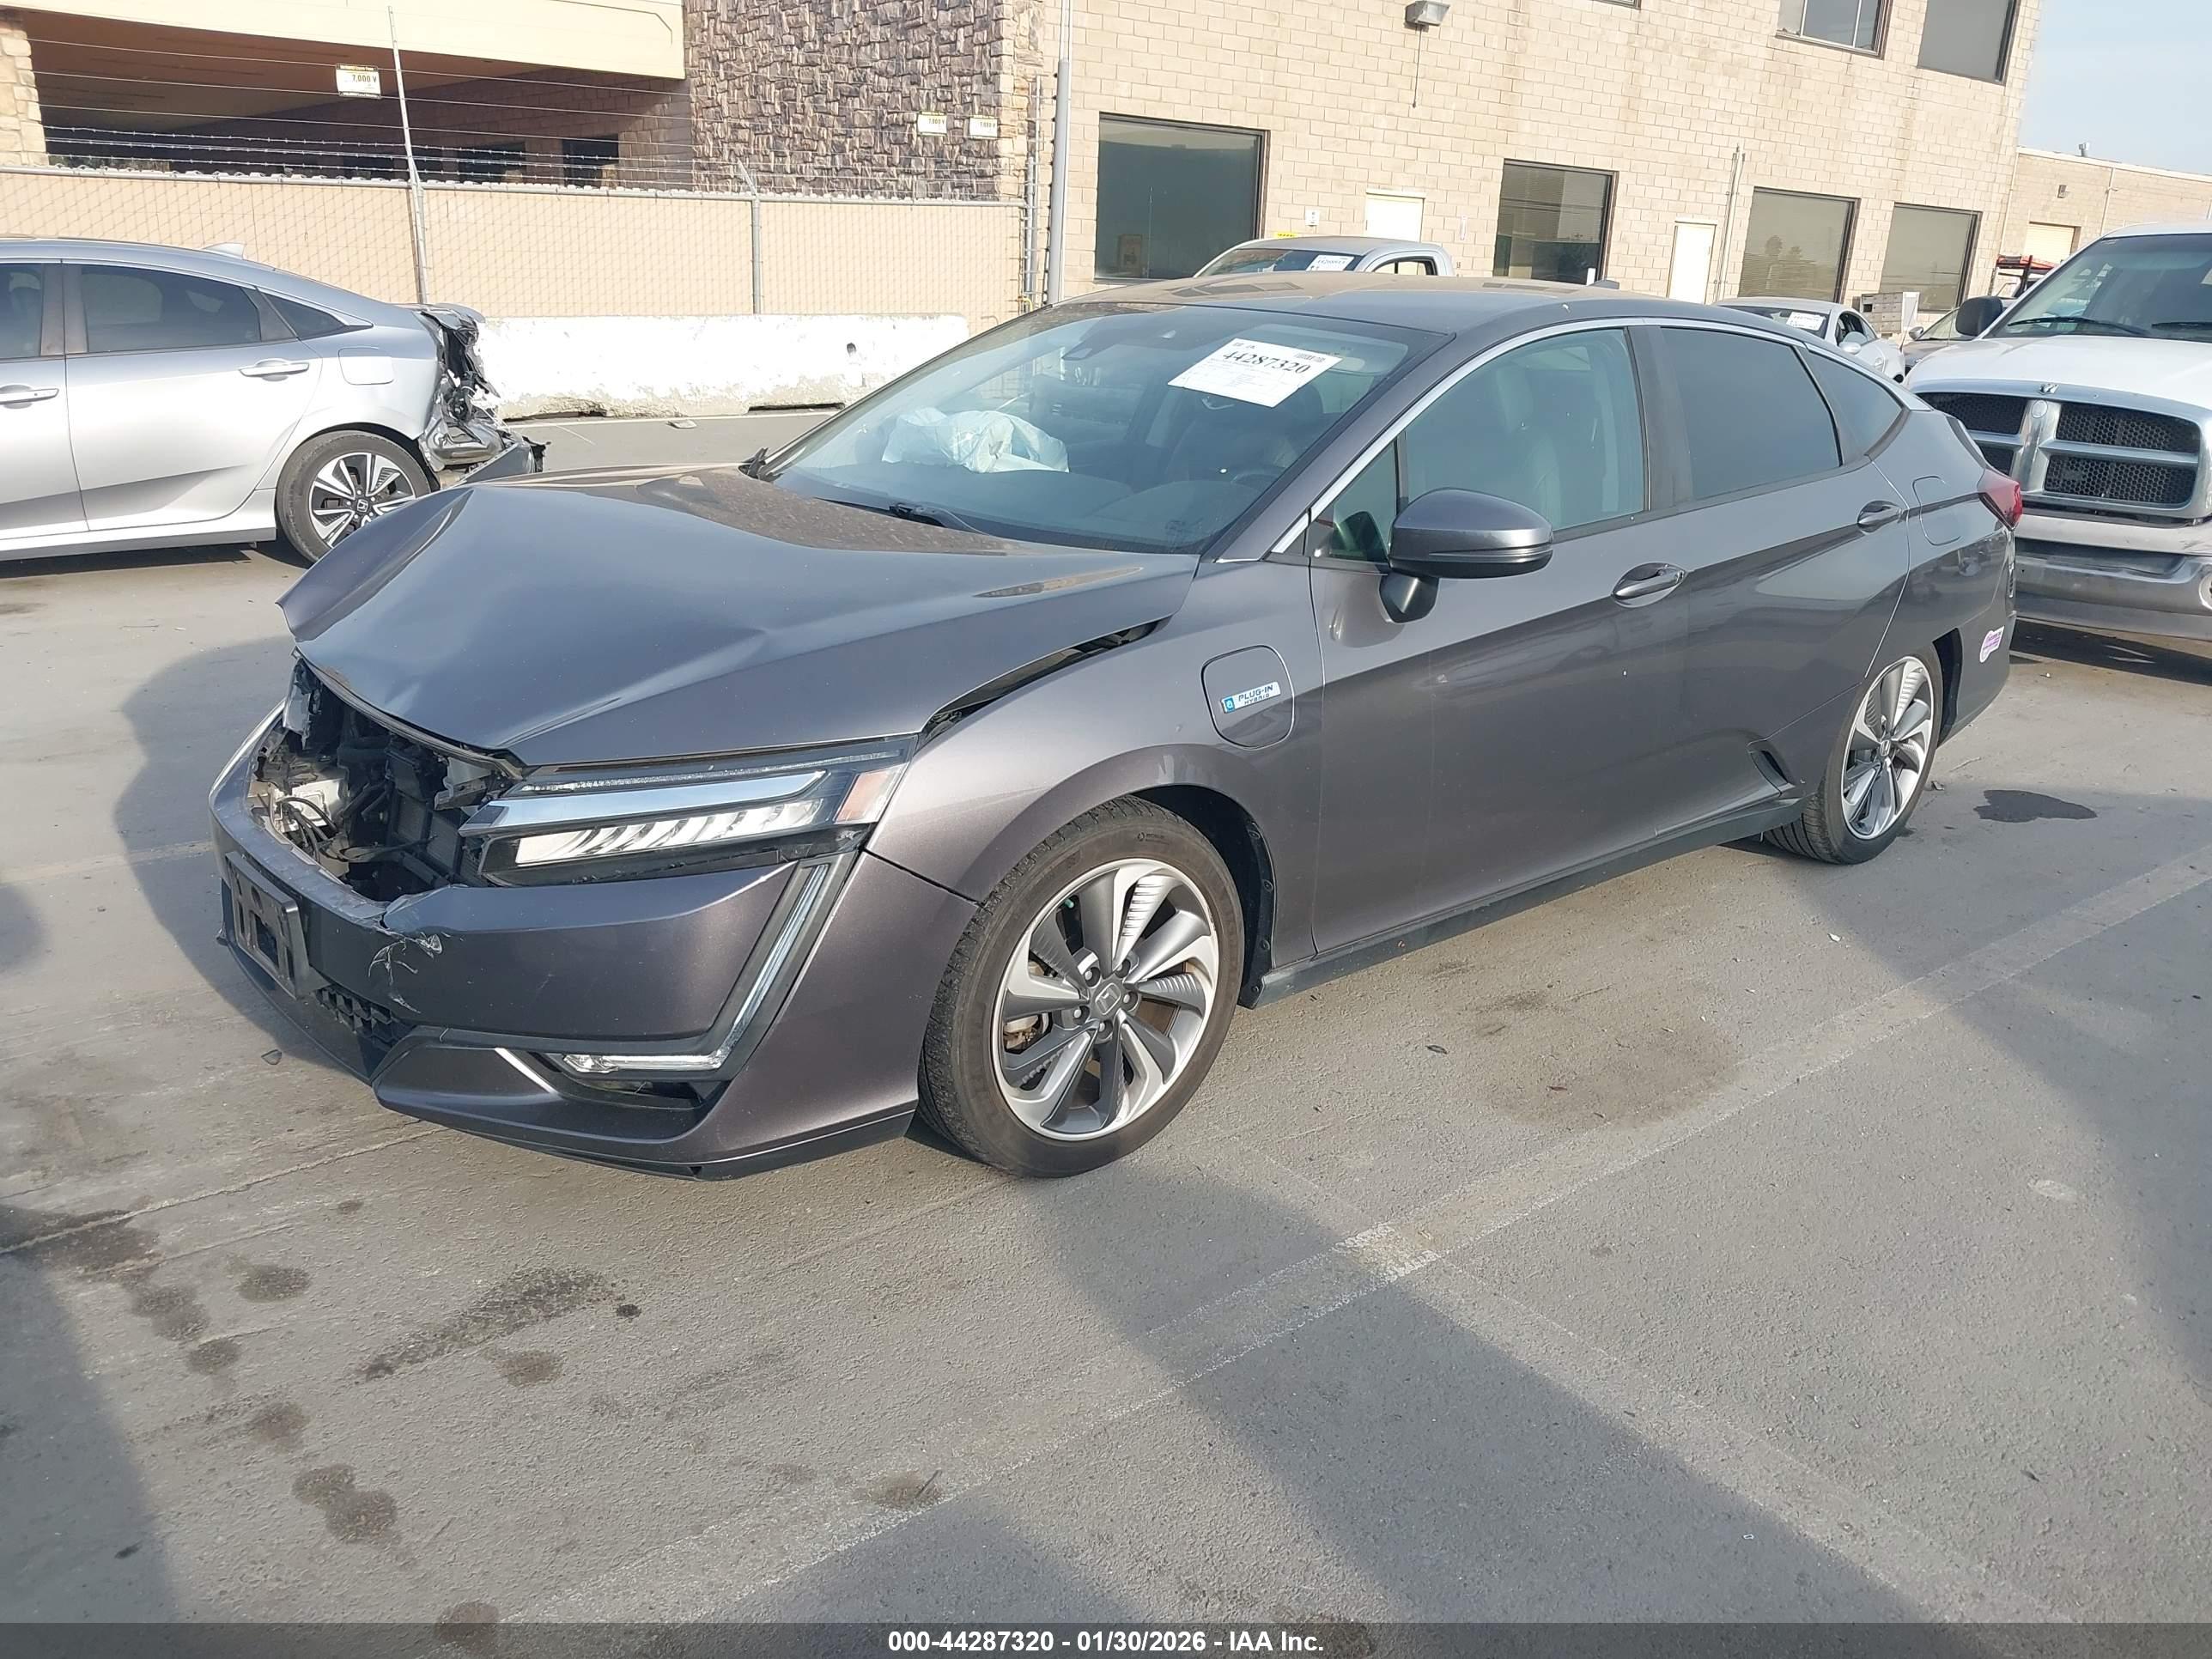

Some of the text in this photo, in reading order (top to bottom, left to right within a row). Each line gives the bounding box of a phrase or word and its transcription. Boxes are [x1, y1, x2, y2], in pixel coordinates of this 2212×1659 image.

[1223, 350, 1311, 374] 44287320
[1238, 684, 1273, 702] PLUG-IN
[1244, 694, 1270, 705] HYBRID
